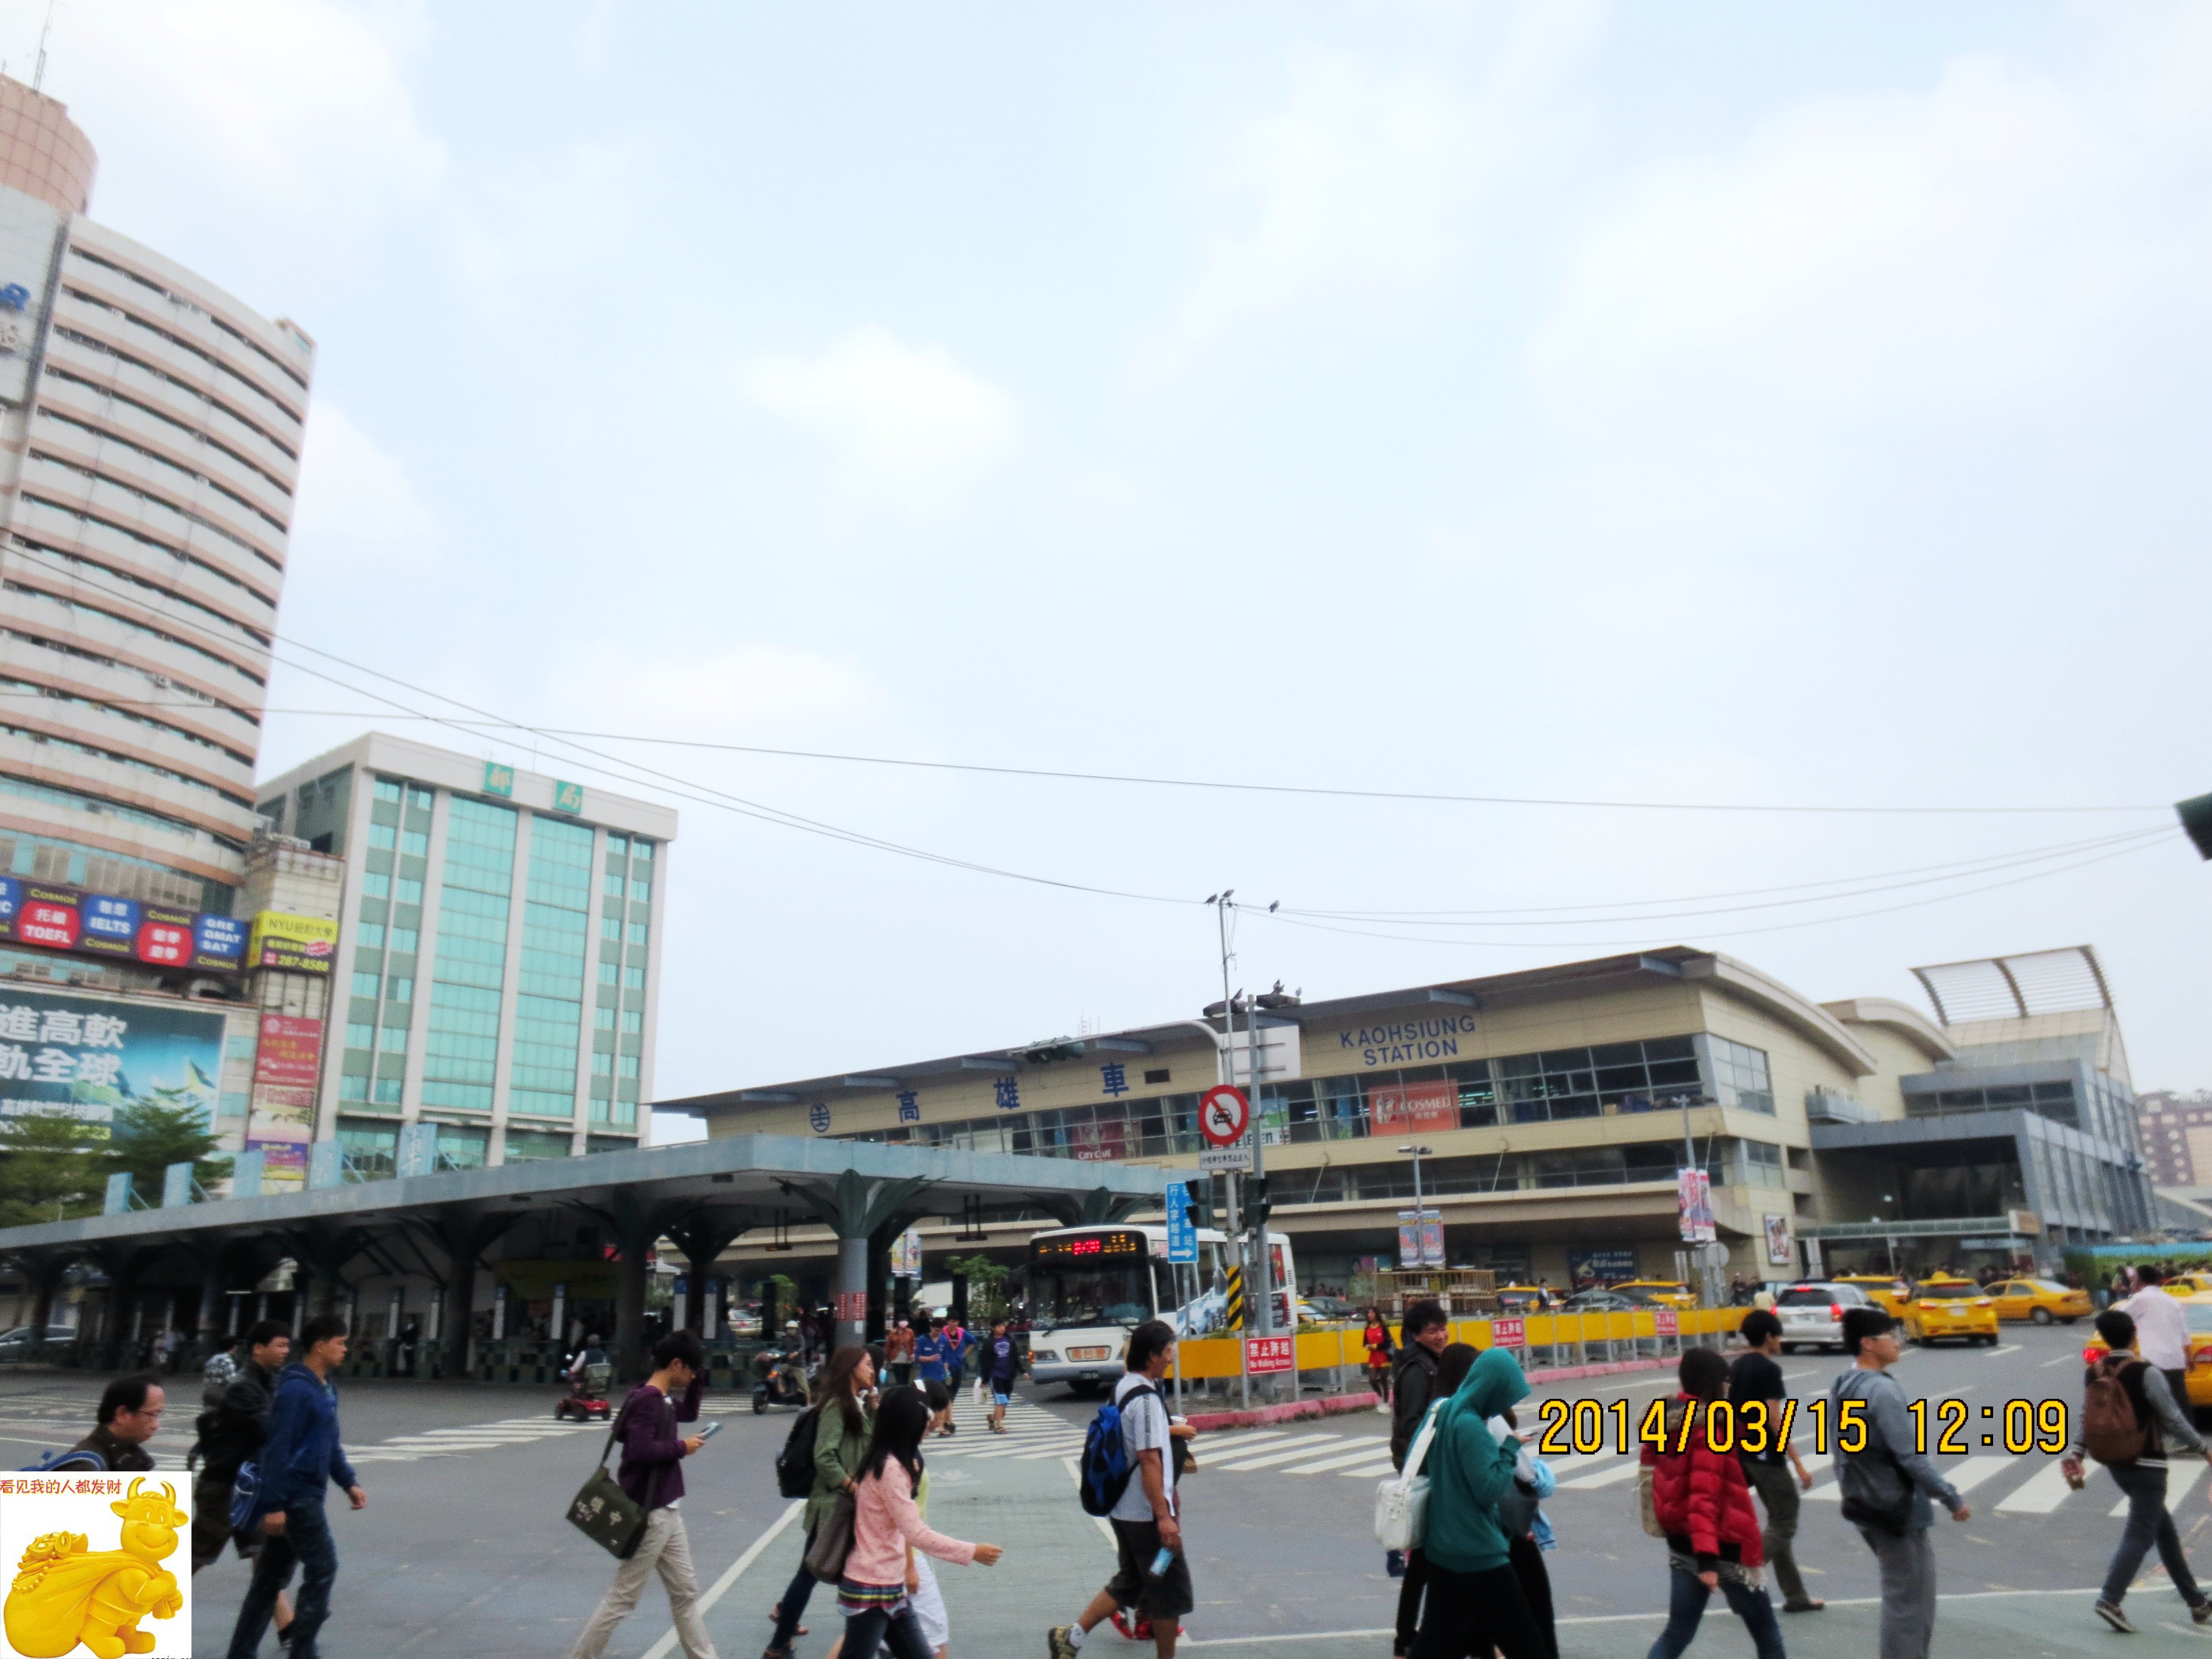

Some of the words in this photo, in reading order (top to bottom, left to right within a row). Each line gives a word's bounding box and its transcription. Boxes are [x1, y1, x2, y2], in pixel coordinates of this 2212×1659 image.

[89, 916, 131, 934] IELTS
[205, 918, 235, 931] GRE
[24, 925, 71, 943] TOEFL
[204, 929, 240, 943] GMAT
[202, 940, 229, 954] SAT
[1340, 1014, 1476, 1049] KAOHSIUNG
[1363, 1038, 1458, 1066] STATION
[1400, 1096, 1451, 1112] COSMED
